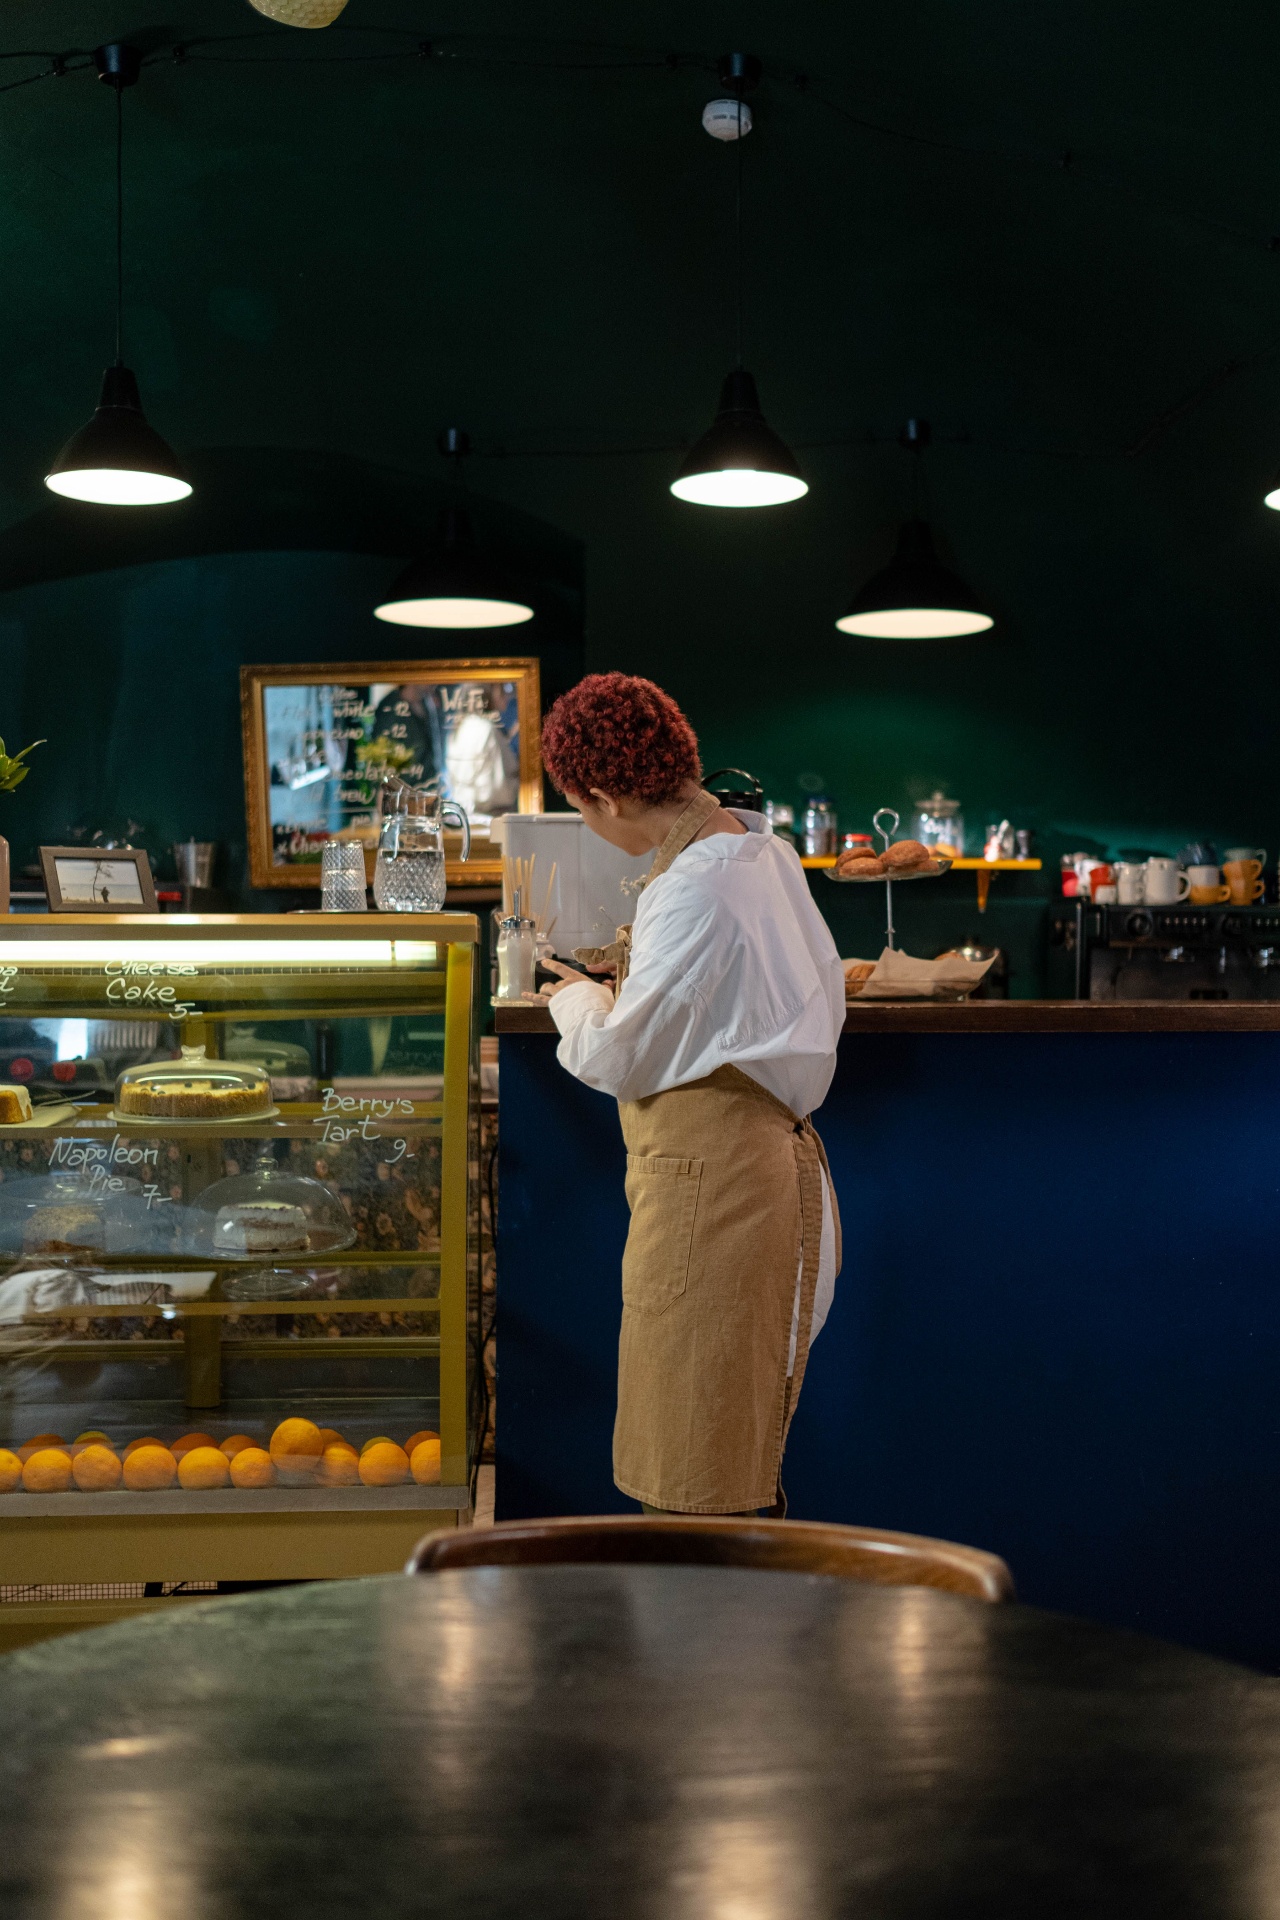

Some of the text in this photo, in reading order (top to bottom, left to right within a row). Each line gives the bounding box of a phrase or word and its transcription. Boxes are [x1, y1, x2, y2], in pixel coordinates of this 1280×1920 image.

[104, 959, 199, 976] Cheese
[105, 977, 177, 1002] Cake
[322, 1087, 415, 1118] Berry's
[312, 1114, 381, 1142] Tart
[48, 1133, 159, 1173] Napoleon
[89, 1164, 126, 1194] Pie
